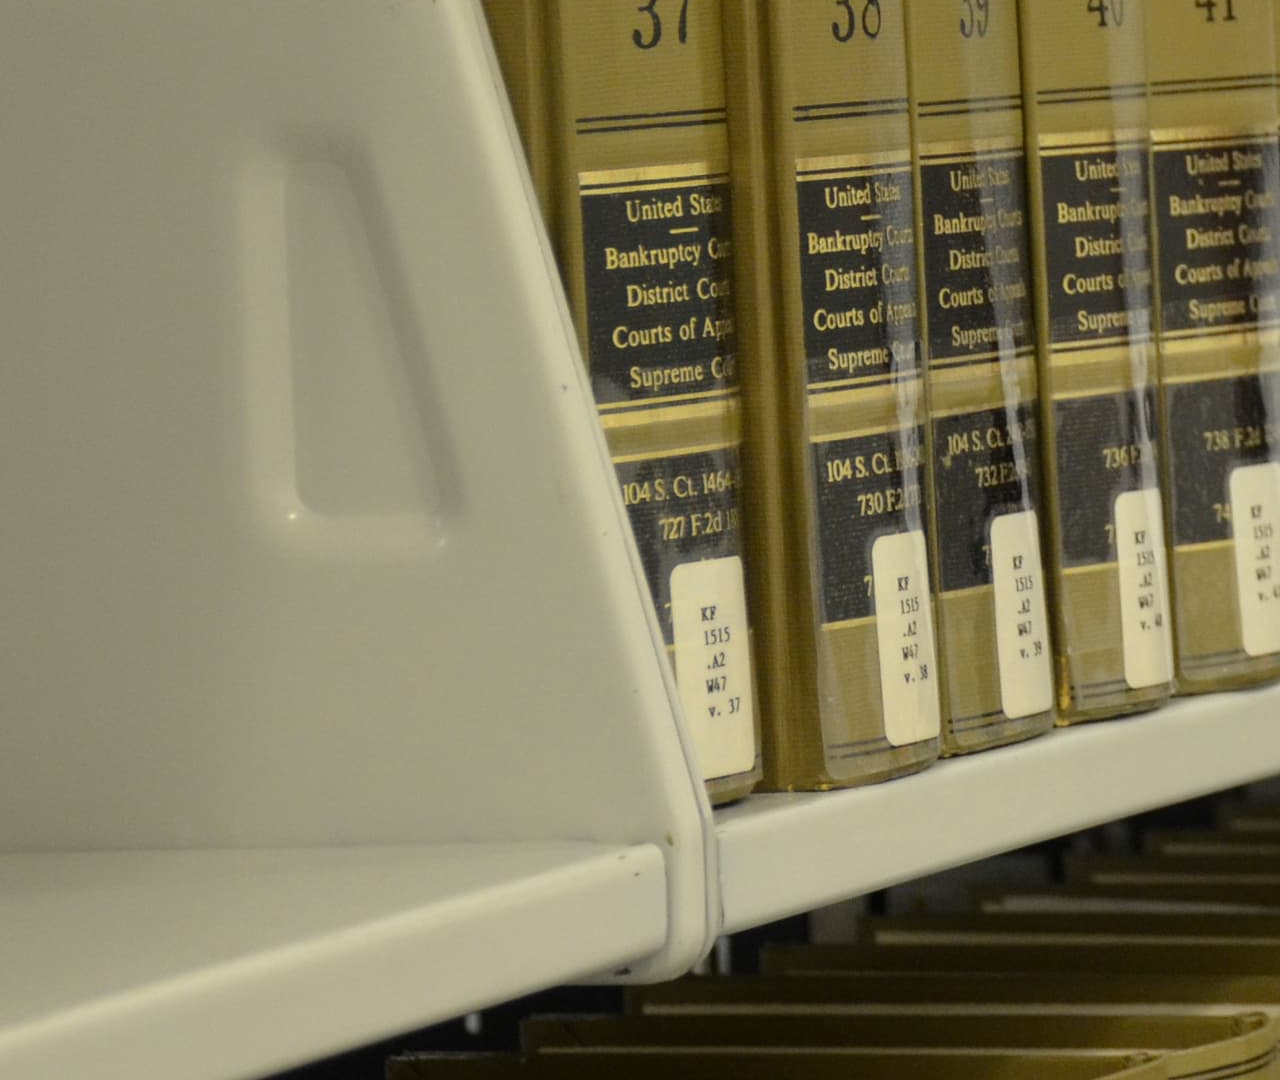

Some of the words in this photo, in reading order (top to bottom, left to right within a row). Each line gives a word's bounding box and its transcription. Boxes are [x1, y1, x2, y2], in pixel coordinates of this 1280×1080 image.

[1186, 154, 1229, 176] United
[626, 194, 683, 222] United
[824, 184, 871, 209] United
[1169, 193, 1243, 217] Bankruptcy
[1057, 200, 1126, 224] Bankrup
[807, 230, 884, 256] Bankruptcy
[1186, 227, 1235, 250] District
[605, 242, 701, 270] Bankruptcy
[825, 267, 878, 291] District
[1063, 273, 1113, 295] Courts
[1175, 263, 1223, 285] Courts
[626, 281, 689, 307] District
[939, 288, 984, 309] Courts
[814, 308, 864, 332] Courts
[870, 301, 883, 323] of
[612, 325, 673, 349] Courts
[680, 317, 697, 341] of
[828, 345, 889, 372] Supreme
[630, 362, 704, 392] Supreme
[947, 432, 969, 456] 104
[971, 430, 984, 452] S.
[1203, 430, 1230, 451] 738
[827, 458, 853, 482] 104
[855, 456, 869, 478] S.
[1103, 446, 1129, 469] 736
[975, 465, 998, 488] 732
[623, 481, 652, 505] 104
[655, 478, 670, 501] S.
[857, 491, 883, 517] 730
[658, 516, 686, 541] 727
[690, 510, 723, 536] F.2d
[897, 576, 909, 592] KF
[1016, 575, 1033, 592] 1515
[701, 606, 717, 622] KF
[901, 597, 919, 615] 1515
[704, 627, 730, 646] 1515
[903, 621, 917, 637] .A2
[707, 652, 726, 669] .A2
[902, 643, 918, 661] W47
[706, 676, 727, 694] W47
[904, 673, 916, 684] v.
[920, 664, 928, 680] 38
[709, 707, 721, 718] v.
[729, 697, 740, 714] 37
